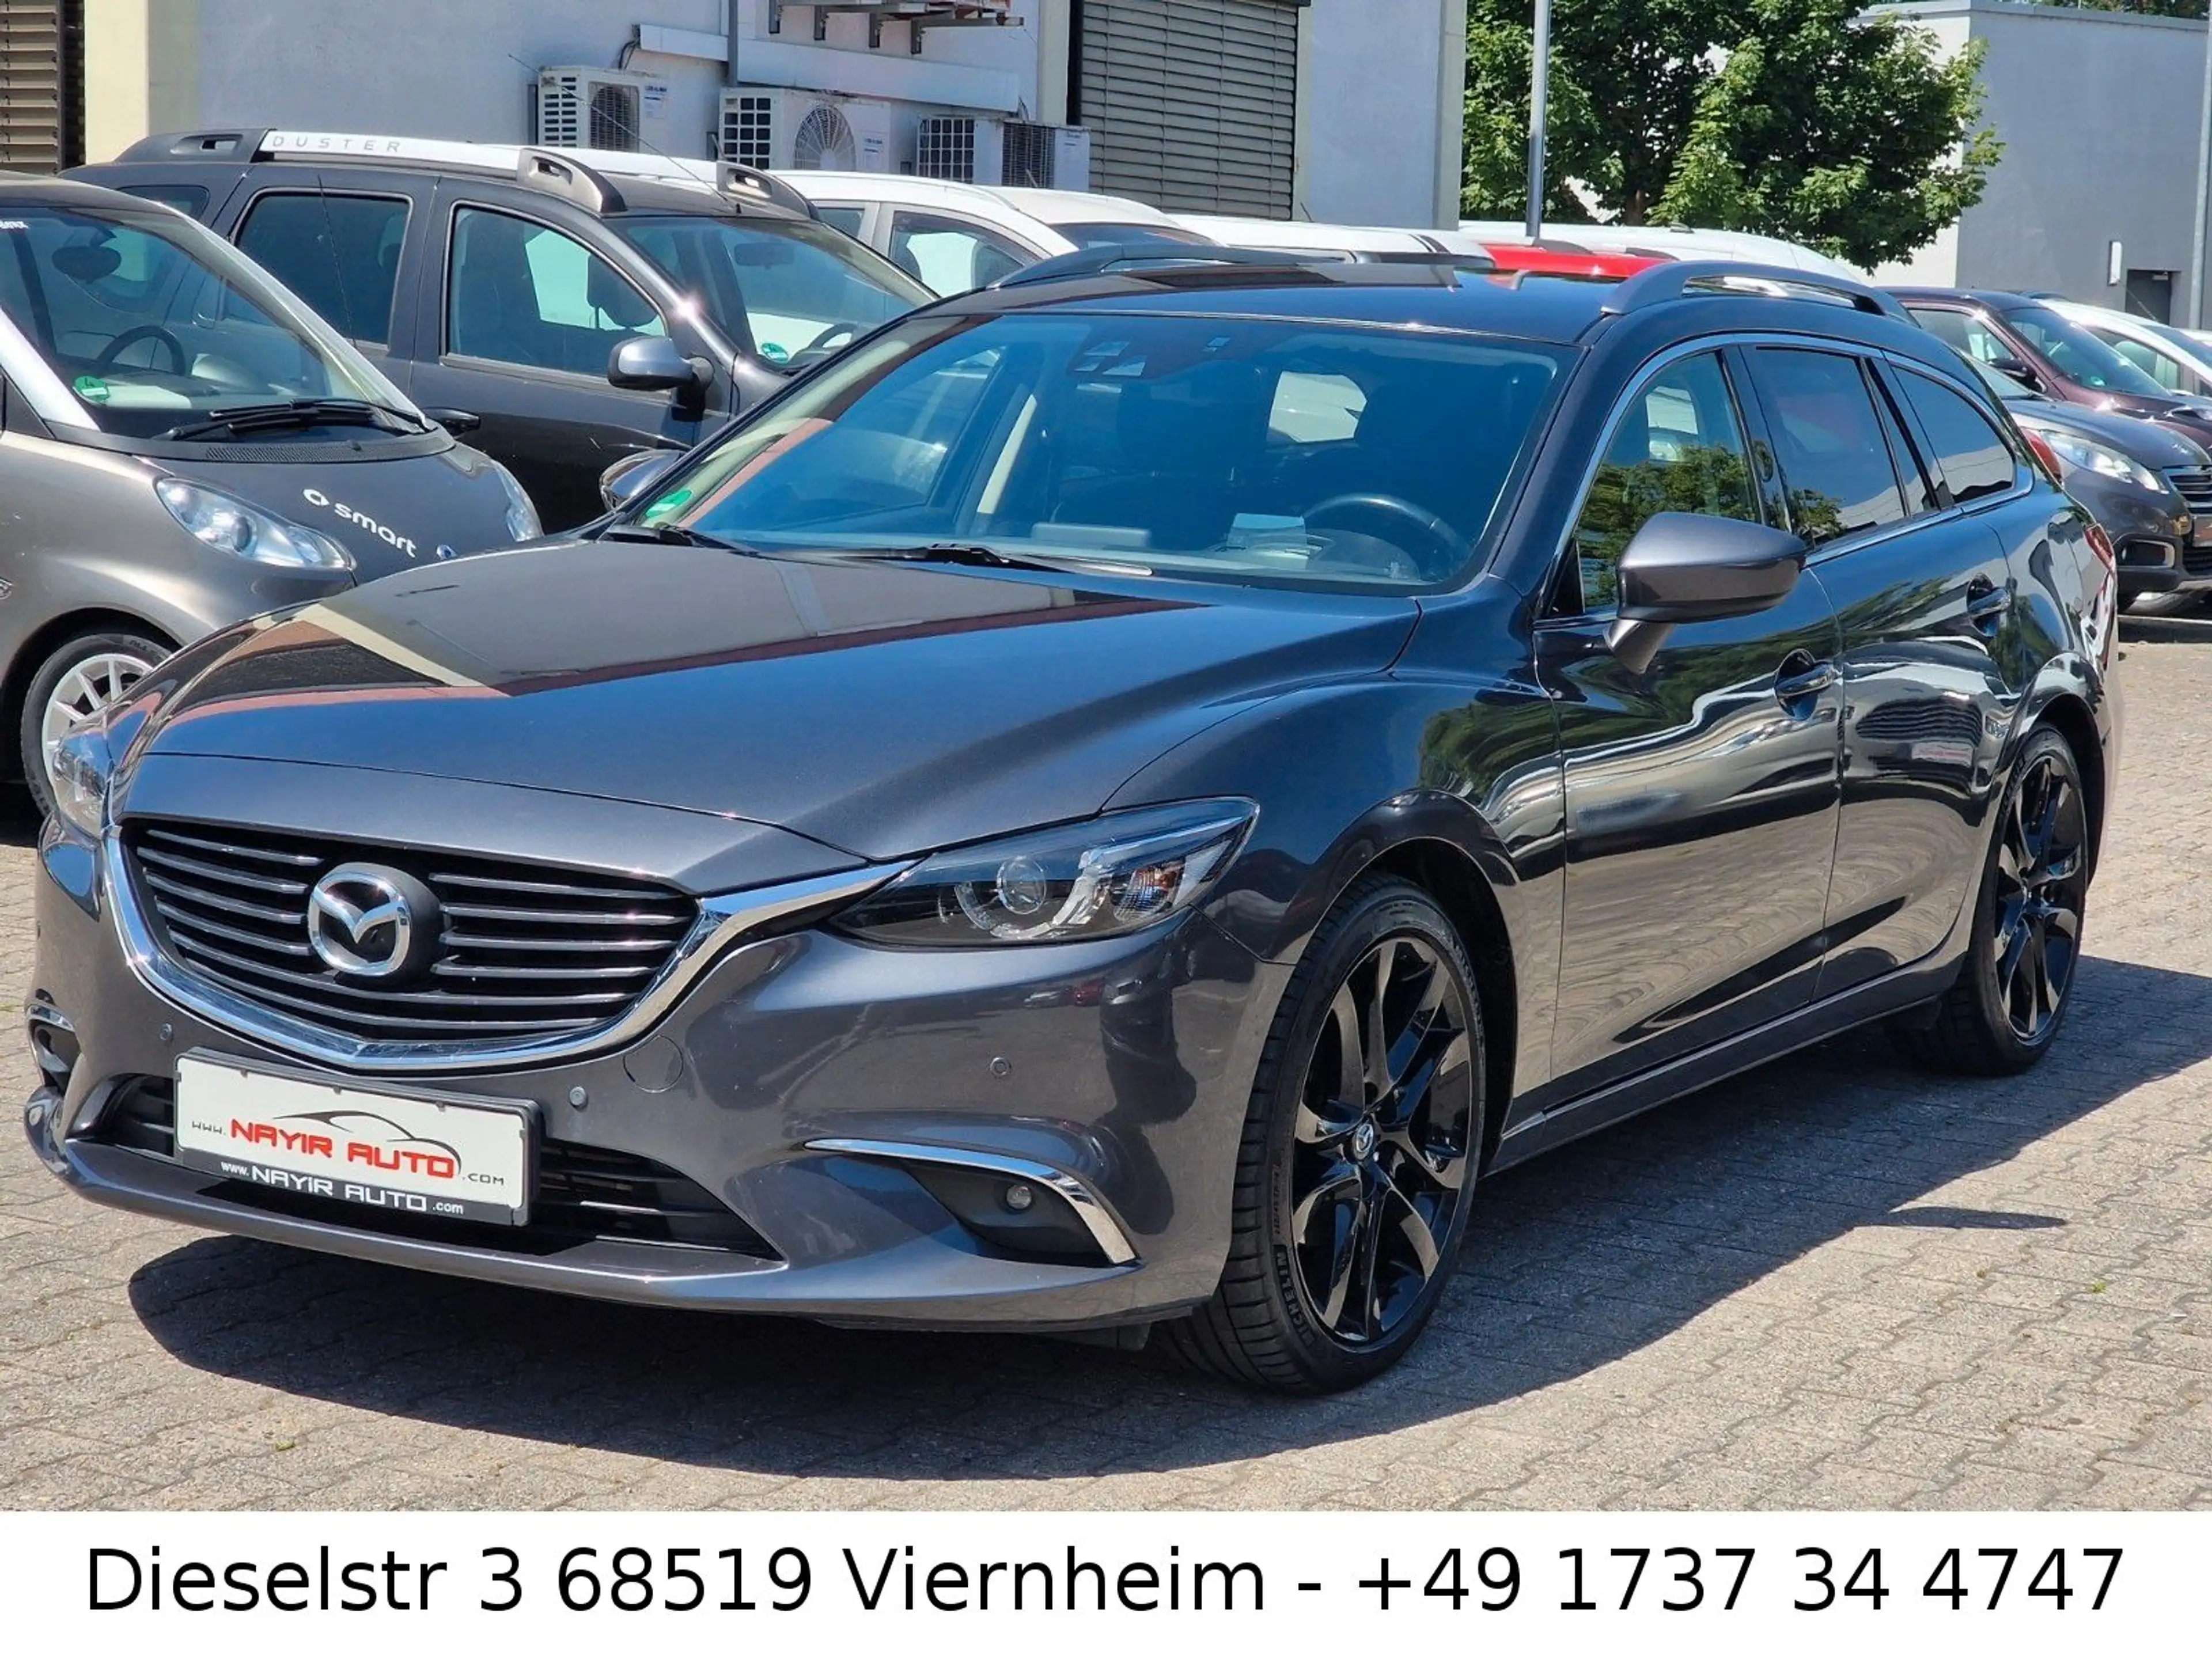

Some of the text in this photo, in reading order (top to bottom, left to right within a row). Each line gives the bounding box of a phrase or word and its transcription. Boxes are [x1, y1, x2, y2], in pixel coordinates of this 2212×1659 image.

[272, 135, 401, 153] DUSTER
[334, 502, 417, 558] smart
[347, 1142, 454, 1179] AUTO
[345, 1184, 426, 1212] AUTO
